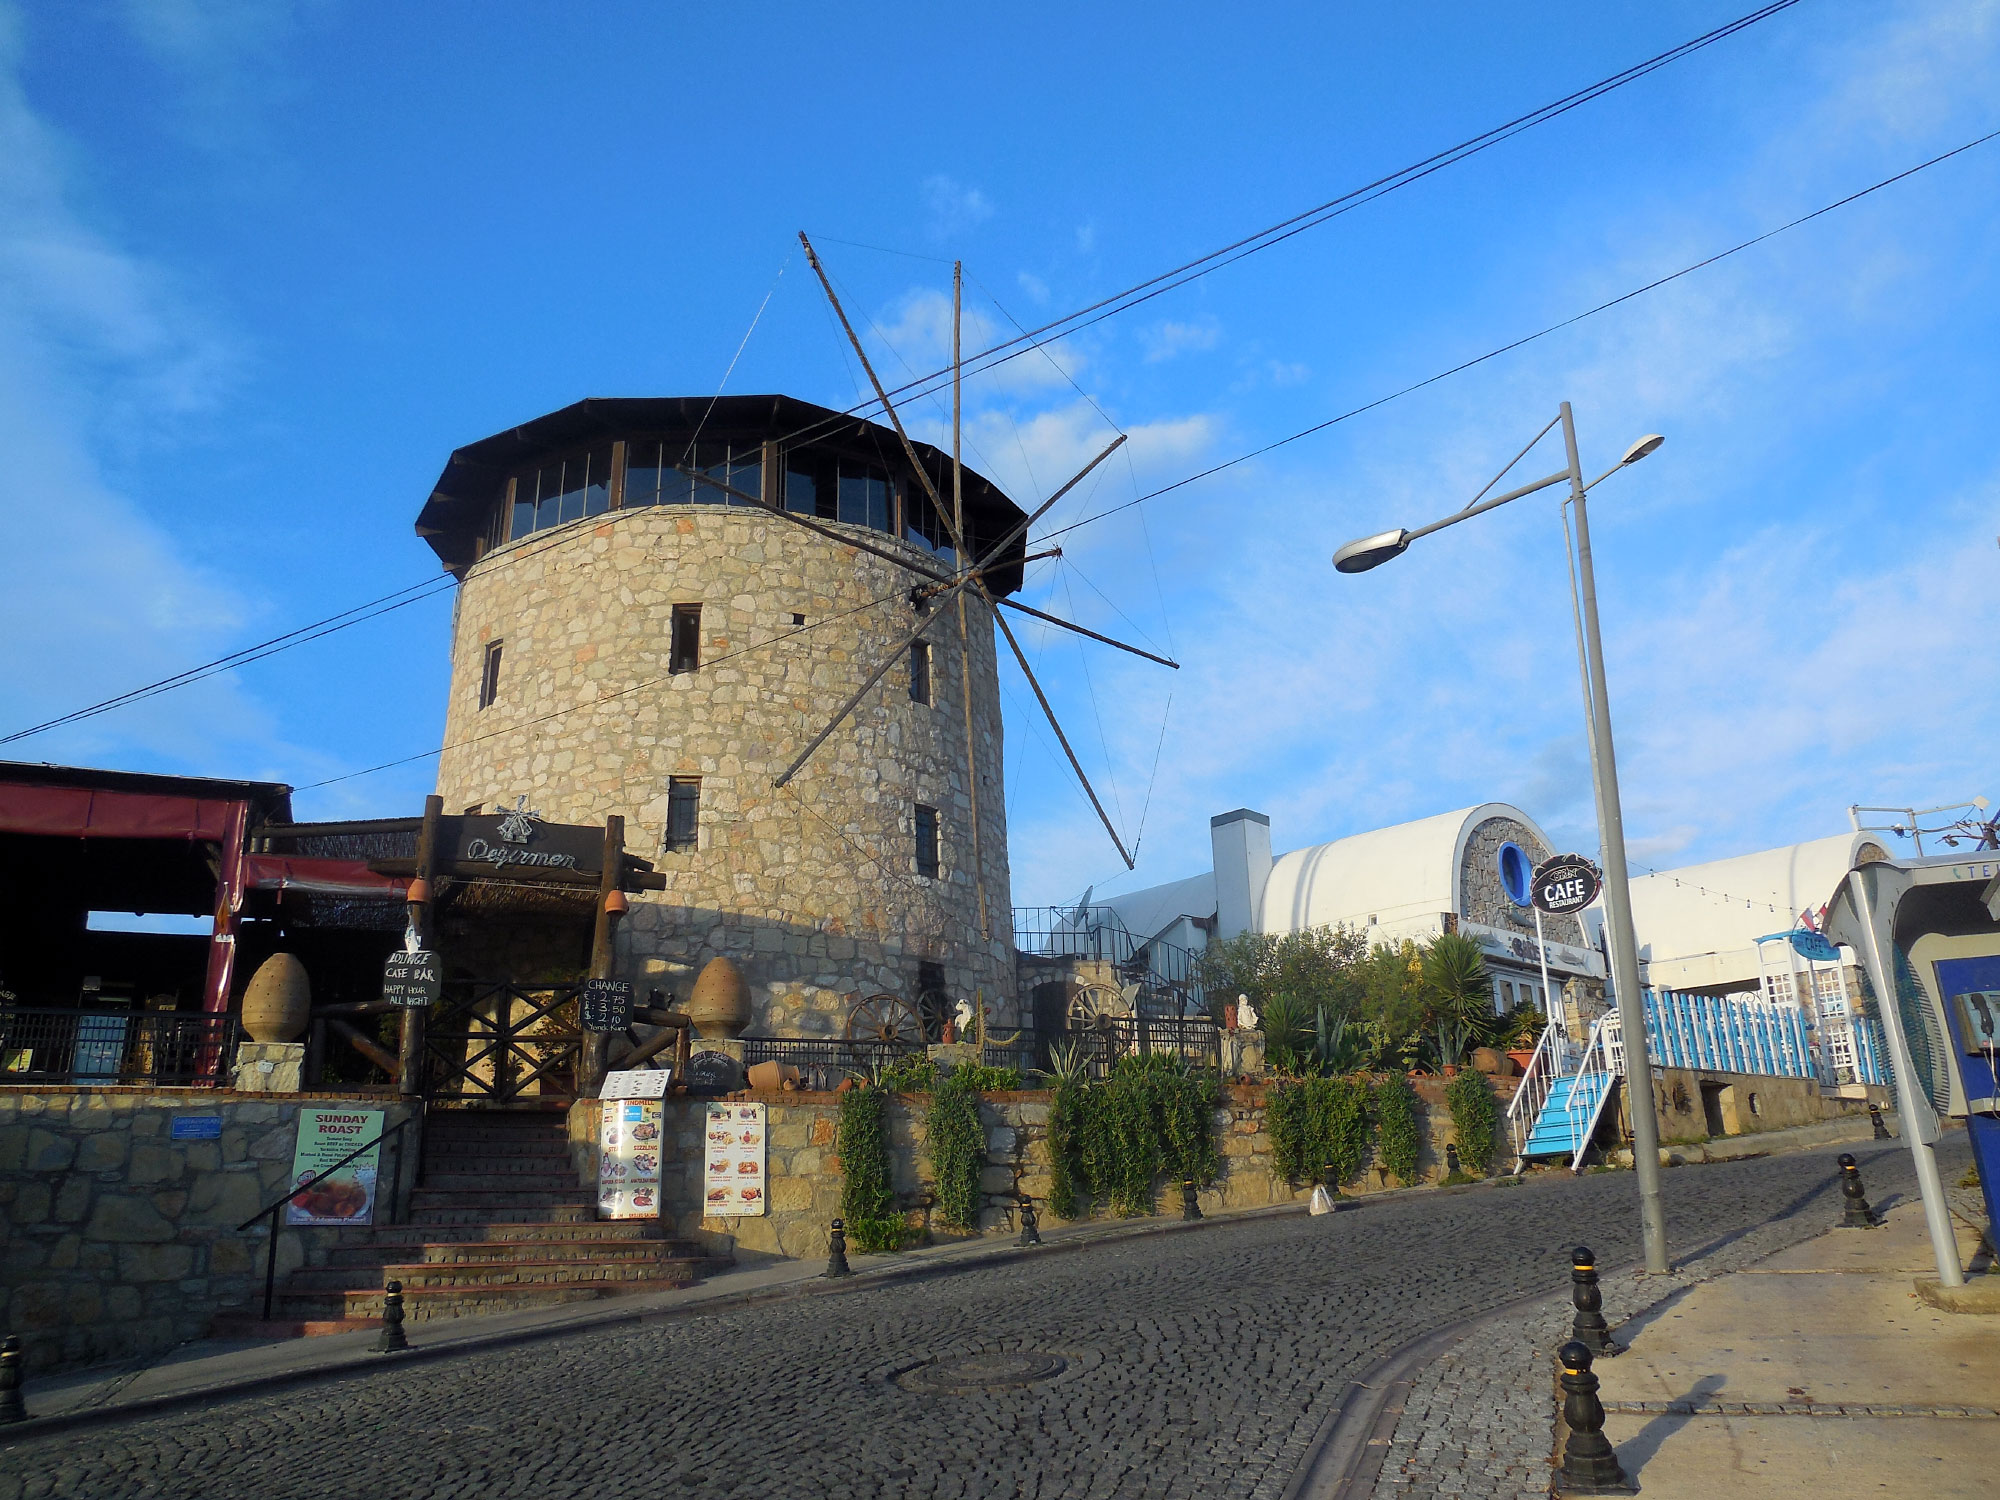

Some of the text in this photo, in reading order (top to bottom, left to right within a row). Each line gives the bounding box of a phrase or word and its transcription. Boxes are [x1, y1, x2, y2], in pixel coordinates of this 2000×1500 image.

[1544, 878, 1586, 902] CAFE
[1548, 895, 1584, 909] RESTAURANT
[387, 952, 433, 966] LOUNGE
[385, 967, 436, 982] CAFE BAR
[383, 984, 427, 995] HAPPY HOUR
[588, 979, 630, 993] CHANGE
[389, 995, 429, 1006] ALL NIGHT
[315, 1114, 369, 1124] SUNDAY
[318, 1124, 364, 1135] ROAST
